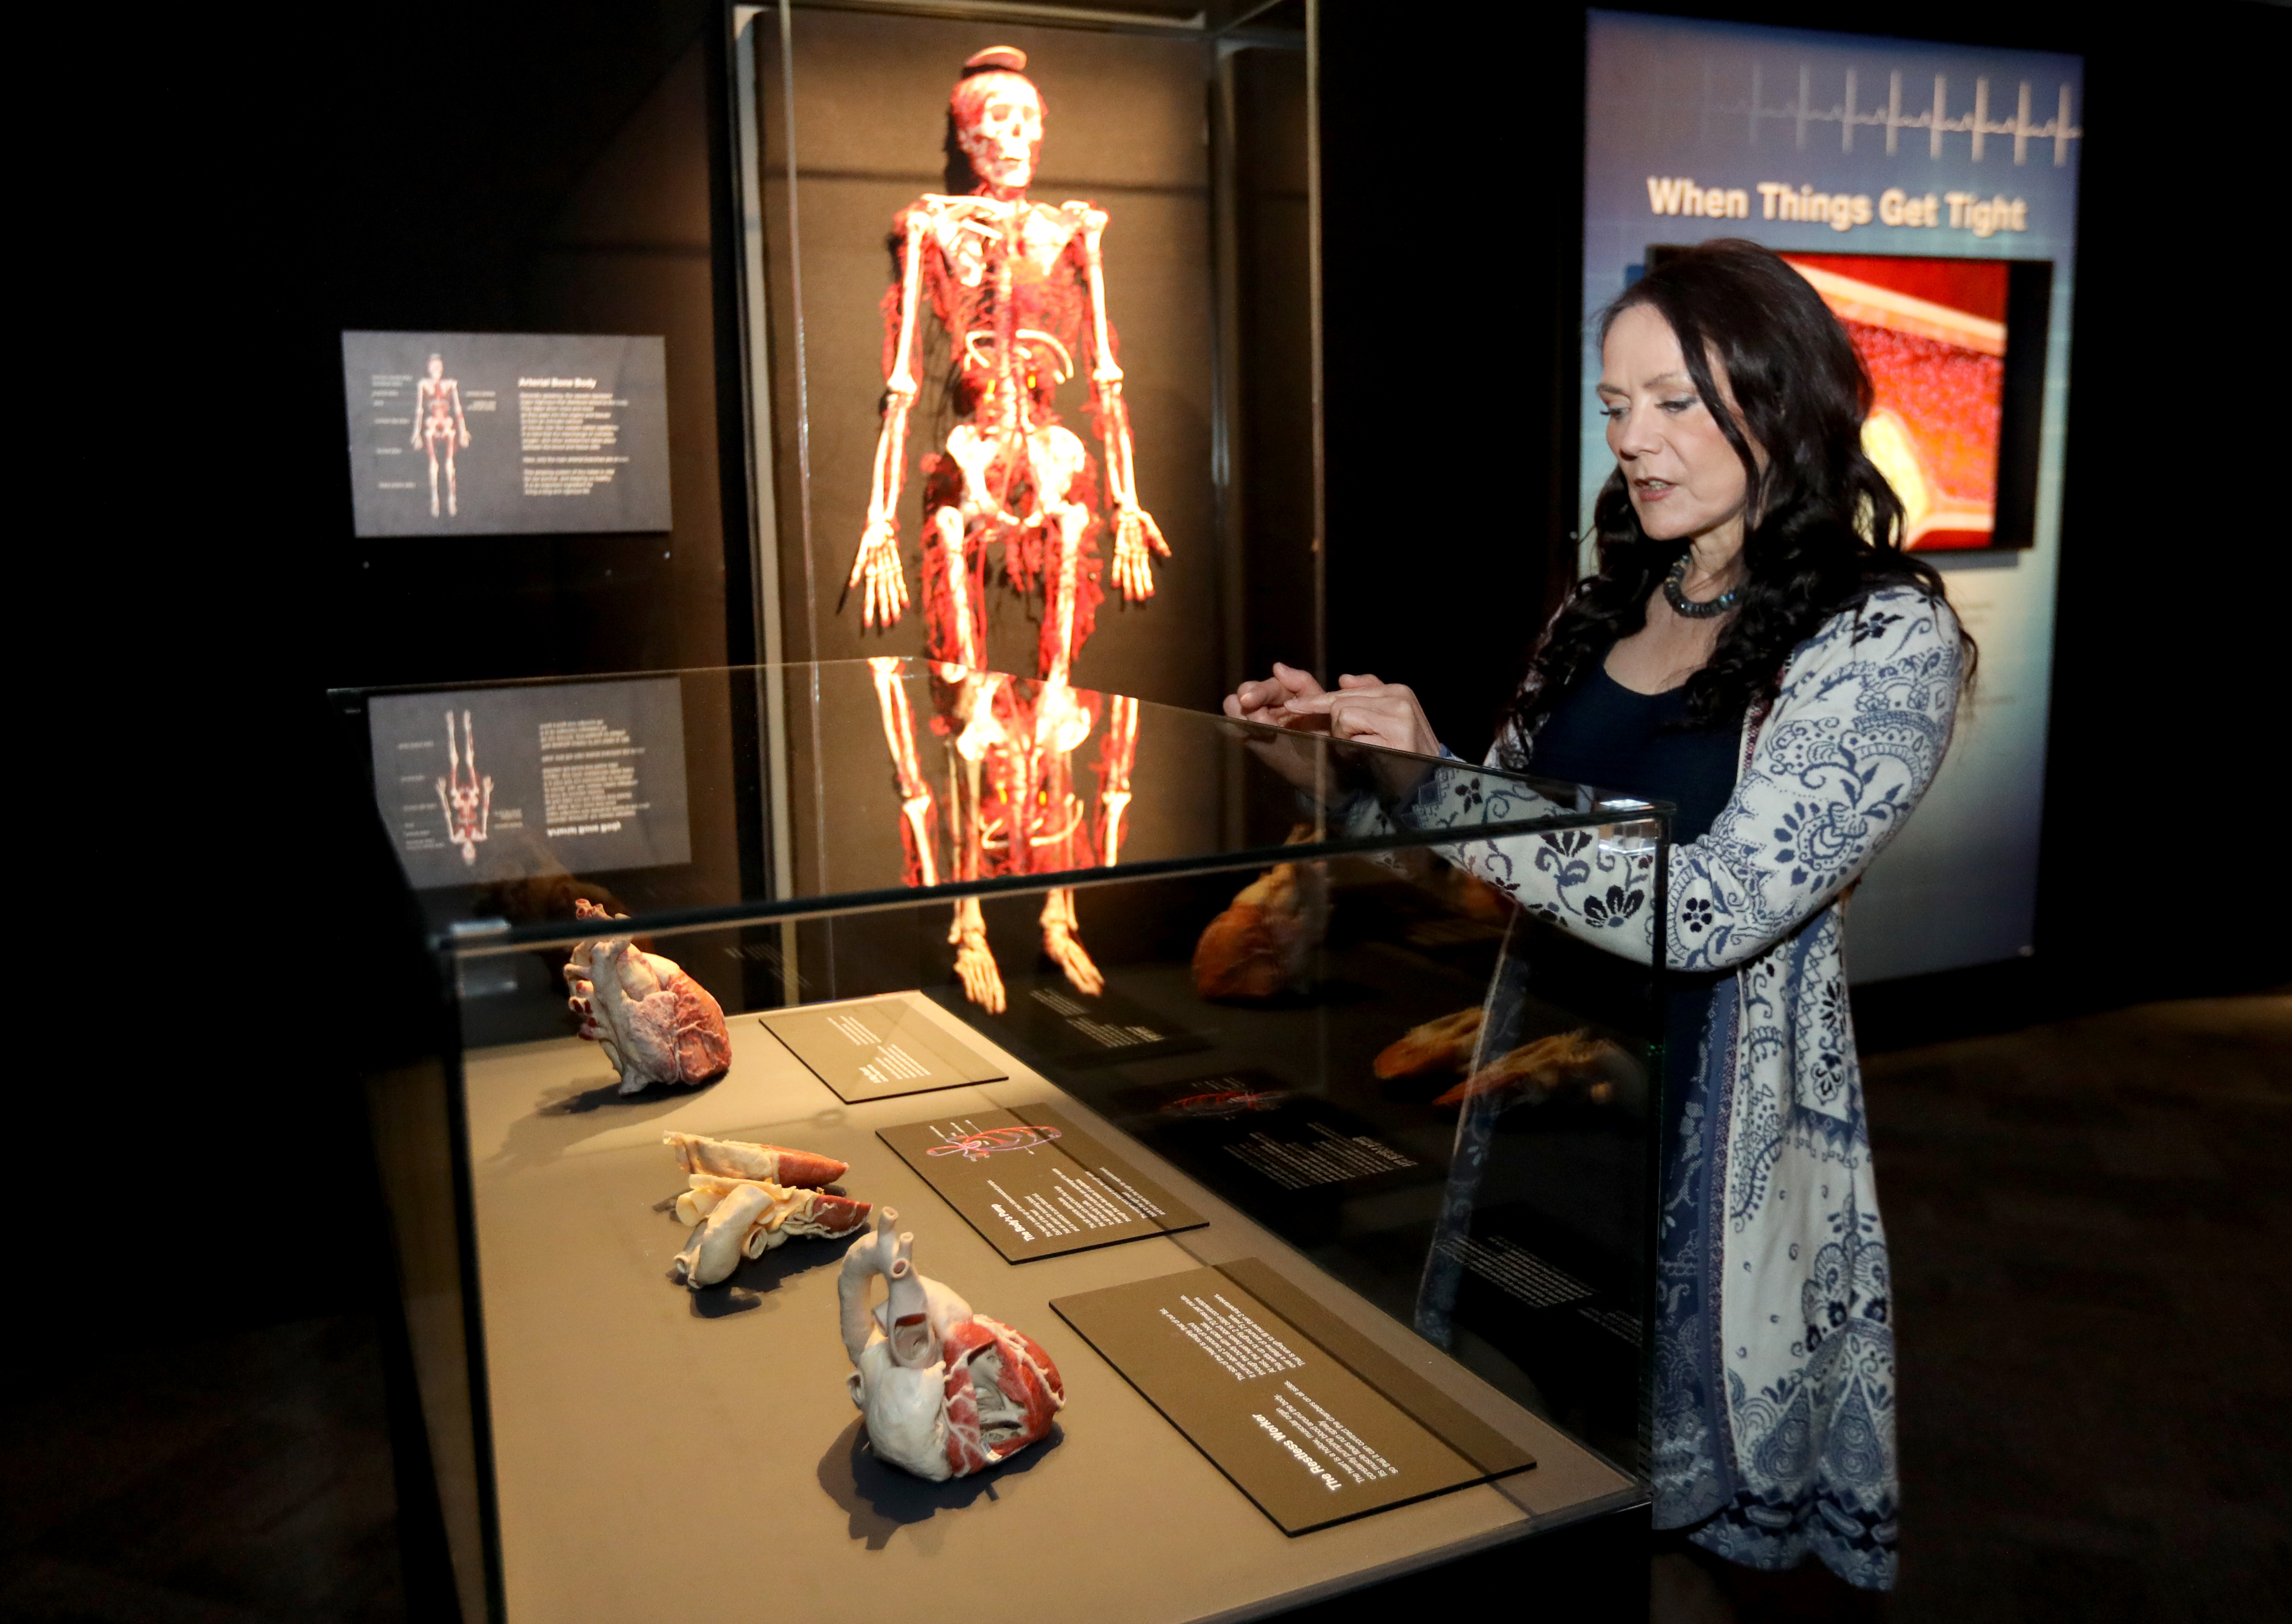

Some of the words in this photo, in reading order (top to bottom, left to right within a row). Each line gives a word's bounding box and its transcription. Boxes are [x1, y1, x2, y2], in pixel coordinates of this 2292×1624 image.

[1647, 176, 1750, 219] When
[1757, 182, 1873, 232] Things
[1879, 188, 1939, 228] Get
[1945, 192, 2028, 237] Tight
[519, 378, 550, 387] Arterial
[552, 378, 574, 388] Bone
[575, 378, 597, 389] Body
[991, 1204, 1010, 1217] Pump
[1004, 1216, 1026, 1233] Body's
[1021, 1231, 1035, 1242] The
[1199, 1311, 1213, 1321] times
[1216, 1315, 1231, 1326] billion
[1242, 1316, 1254, 1325] than
[1176, 1323, 1188, 1331] that
[1187, 1322, 1203, 1333] blood
[1216, 1325, 1231, 1335] about
[1251, 1324, 1265, 1333] more
[1182, 1330, 1202, 1343] roughly
[1210, 1330, 1223, 1339] each
[1228, 1335, 1243, 1345] beats
[1236, 1332, 1254, 1345] roughly
[1243, 1328, 1262, 1341] around
[1204, 1336, 1222, 1349] ounces
[1220, 1338, 1231, 1346] with
[1272, 1340, 1291, 1354] enough
[1202, 1345, 1217, 1356] heart
[1228, 1346, 1243, 1356] body
[1239, 1344, 1253, 1354] heart
[1222, 1351, 1238, 1362] about
[1263, 1353, 1277, 1363] adds
[1292, 1356, 1306, 1367] That
[1226, 1364, 1238, 1373] size
[1235, 1361, 1254, 1375] pumps
[1247, 1361, 1266, 1376] through
[1274, 1362, 1286, 1371] This
[1283, 1359, 1296, 1368] over
[1234, 1372, 1246, 1381] The
[1276, 1407, 1292, 1420] organ
[1286, 1405, 1297, 1413] the
[1309, 1401, 1335, 1422] chambers
[1292, 1411, 1314, 1427] around
[1252, 1414, 1286, 1441] Worker
[1289, 1420, 1314, 1438] muscular
[1318, 1420, 1338, 1435] spirally
[1333, 1421, 1344, 1429] the
[1309, 1426, 1328, 1439] blood
[1335, 1434, 1347, 1442] run
[1340, 1428, 1364, 1446] contract
[1312, 1438, 1332, 1454] hollow,
[1325, 1438, 1352, 1457] pumping
[1344, 1442, 1361, 1455] fibers
[1362, 1445, 1375, 1455] can
[1283, 1440, 1325, 1474] Restless
[1358, 1454, 1381, 1471] muscle
[1376, 1457, 1391, 1468] that
[1337, 1461, 1355, 1474] heart
[1347, 1457, 1377, 1480] constantly
[1377, 1469, 1388, 1477] Its
[1388, 1466, 1399, 1475] so
[1321, 1473, 1342, 1491] The
[1352, 1473, 1365, 1484] The
